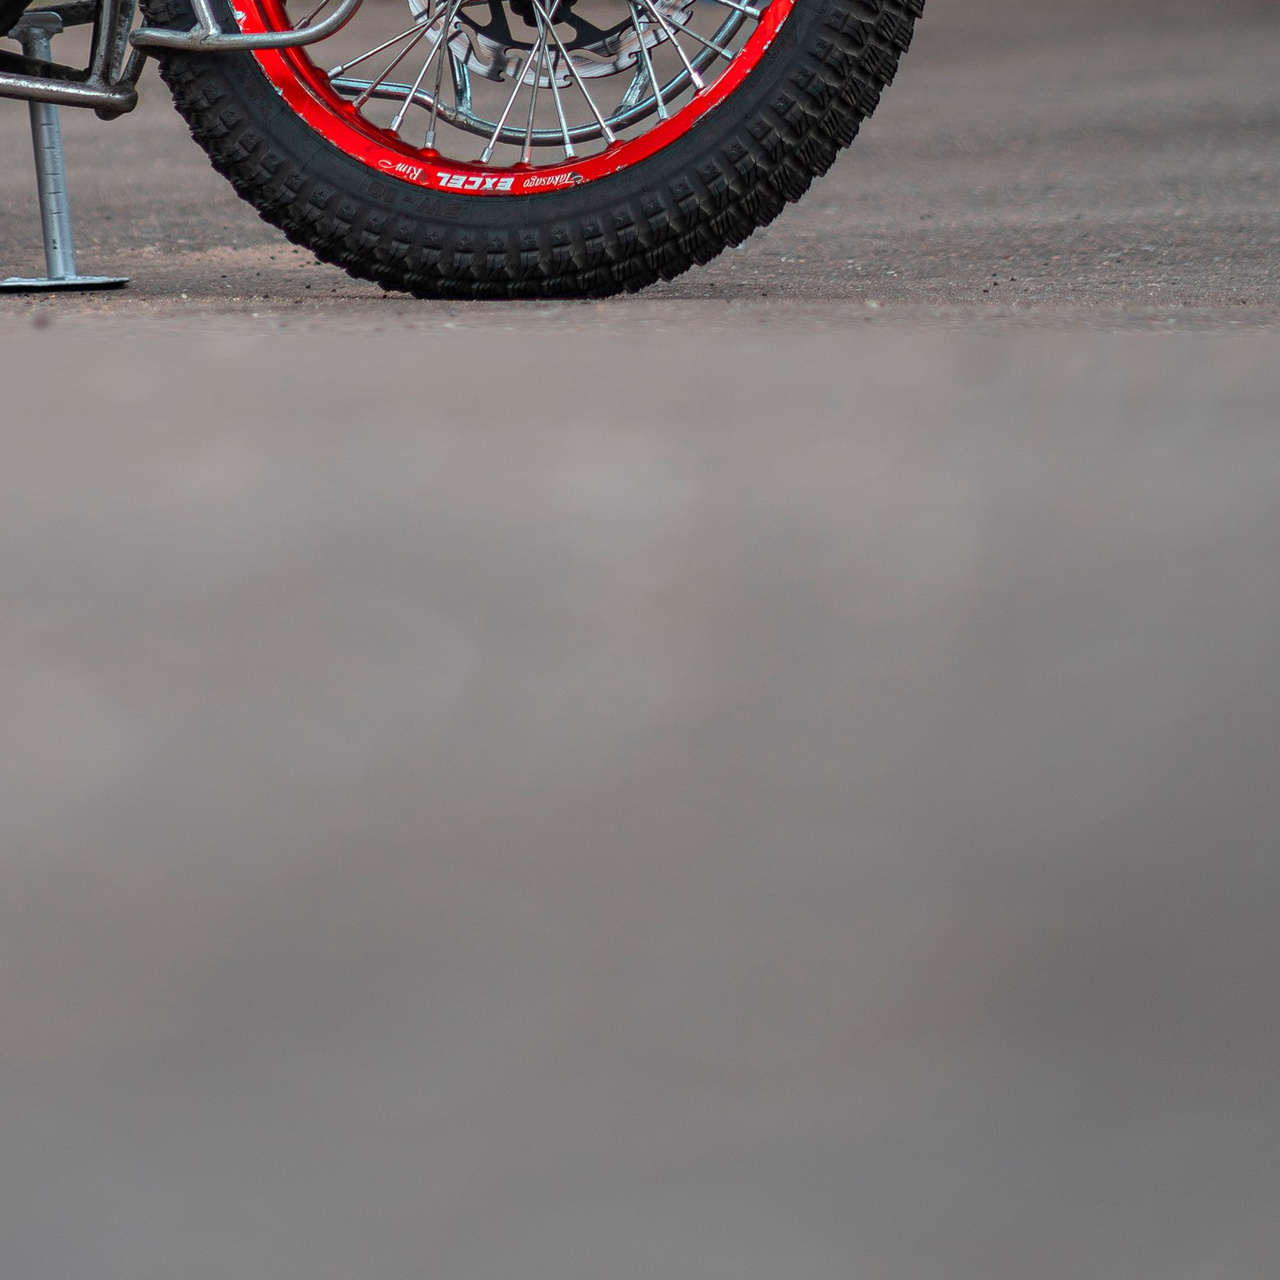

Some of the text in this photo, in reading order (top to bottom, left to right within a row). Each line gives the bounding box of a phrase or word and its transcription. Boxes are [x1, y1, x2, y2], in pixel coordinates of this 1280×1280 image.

[378, 159, 584, 191] Takasago EXCEL Rim
